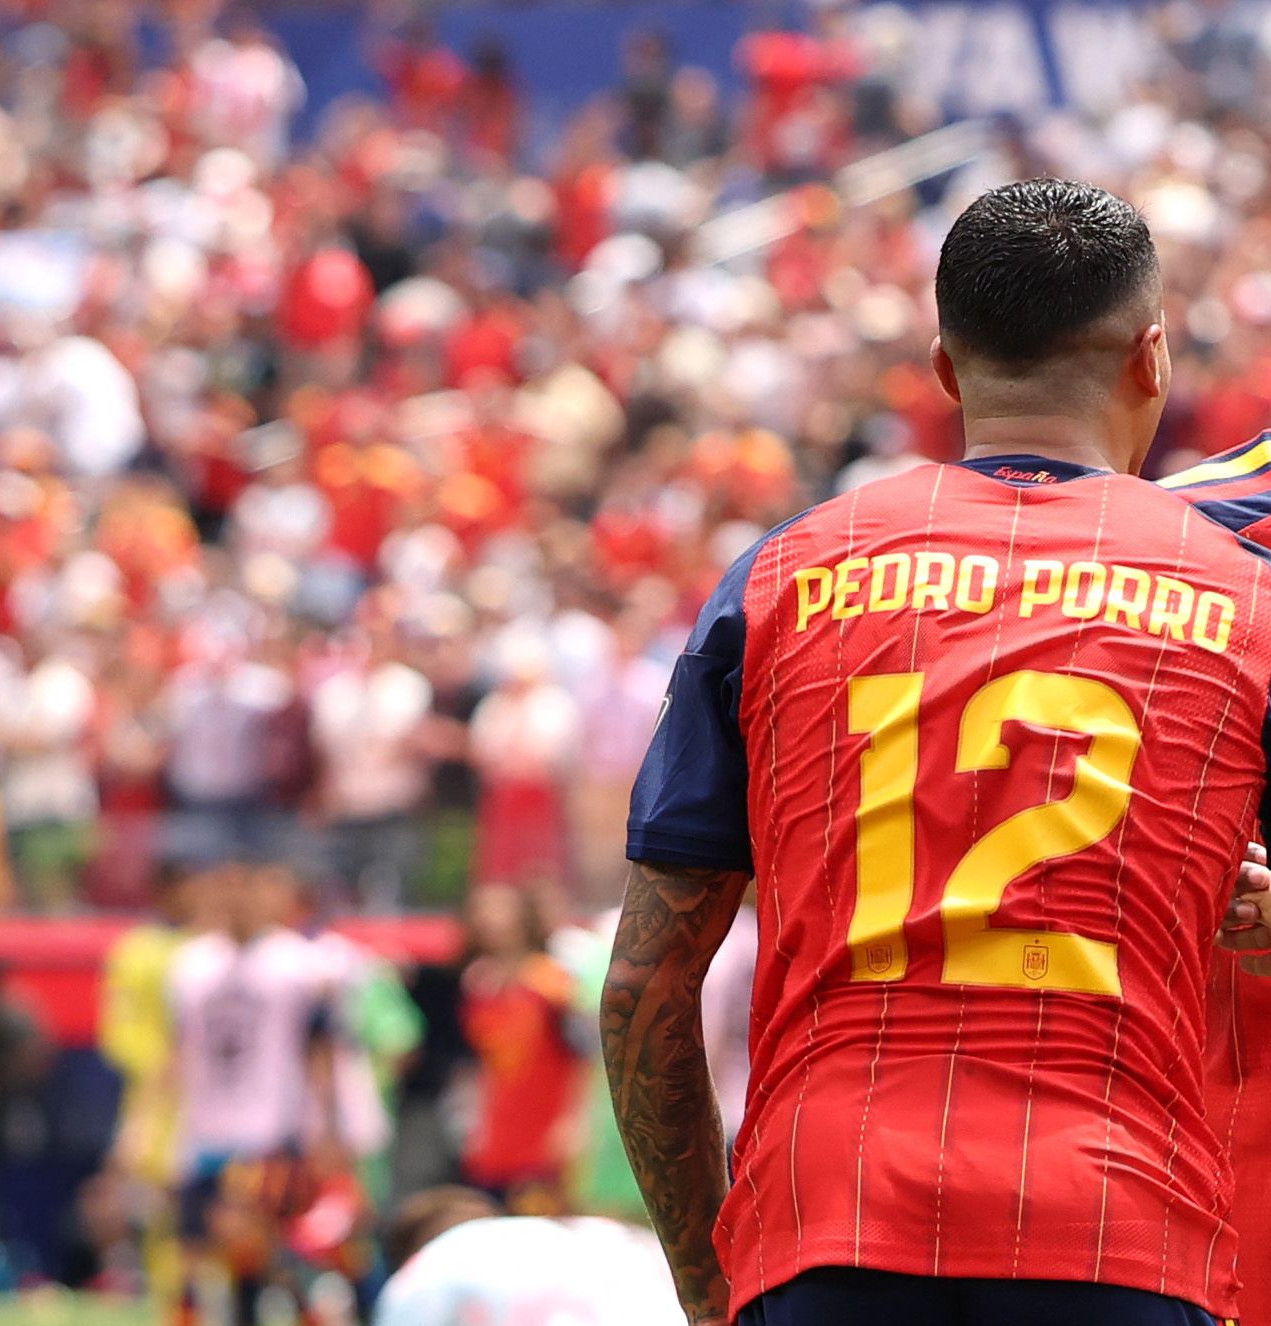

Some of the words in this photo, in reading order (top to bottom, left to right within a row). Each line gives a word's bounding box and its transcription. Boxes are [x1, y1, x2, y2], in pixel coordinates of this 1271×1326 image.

[793, 551, 1000, 633] PEDRO
[1018, 559, 1236, 654] PORRO
[847, 669, 1141, 997] 12
